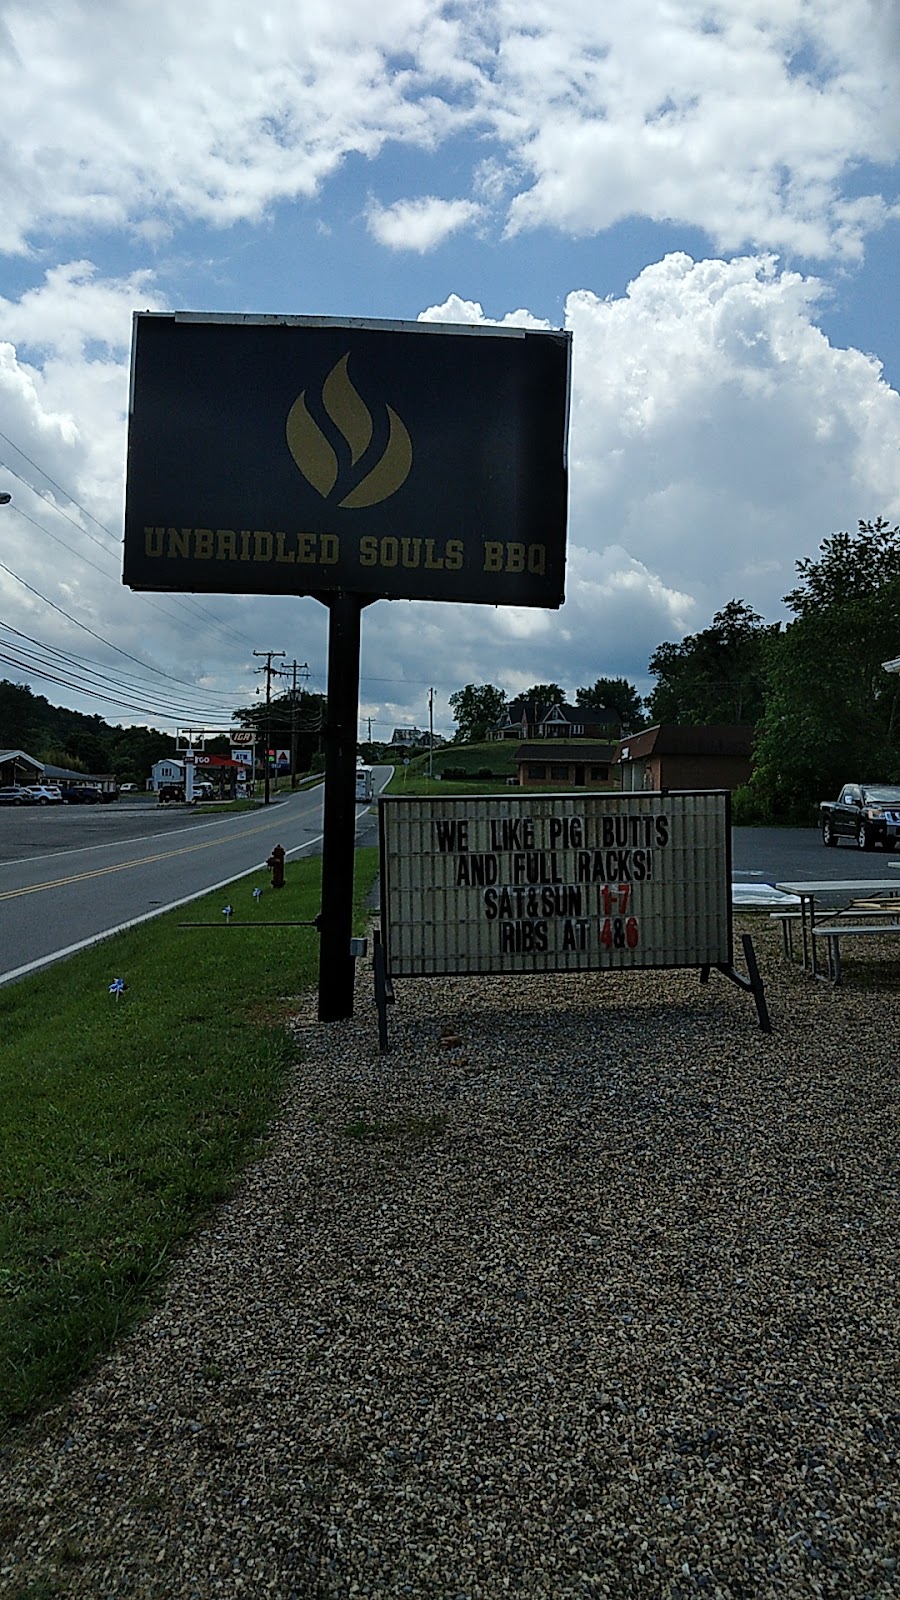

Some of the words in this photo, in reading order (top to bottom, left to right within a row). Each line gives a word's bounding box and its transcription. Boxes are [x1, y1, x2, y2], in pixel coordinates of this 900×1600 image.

[143, 526, 341, 566] UNBRIDLED
[359, 535, 465, 571] SOULS
[483, 540, 548, 576] BBQ
[233, 732, 251, 741] IGA
[436, 819, 469, 852] WE
[491, 817, 534, 851] LIKE
[549, 816, 583, 849] PIG
[603, 814, 669, 848] BUTTS
[456, 853, 498, 887] AND
[513, 851, 562, 885] FULL
[579, 849, 652, 883] RACKS!
[484, 886, 580, 920] SAT&SUN
[601, 883, 631, 915] 1-7
[502, 919, 549, 953] RIBS
[562, 918, 590, 951] AT
[599, 916, 639, 949] 4&6
